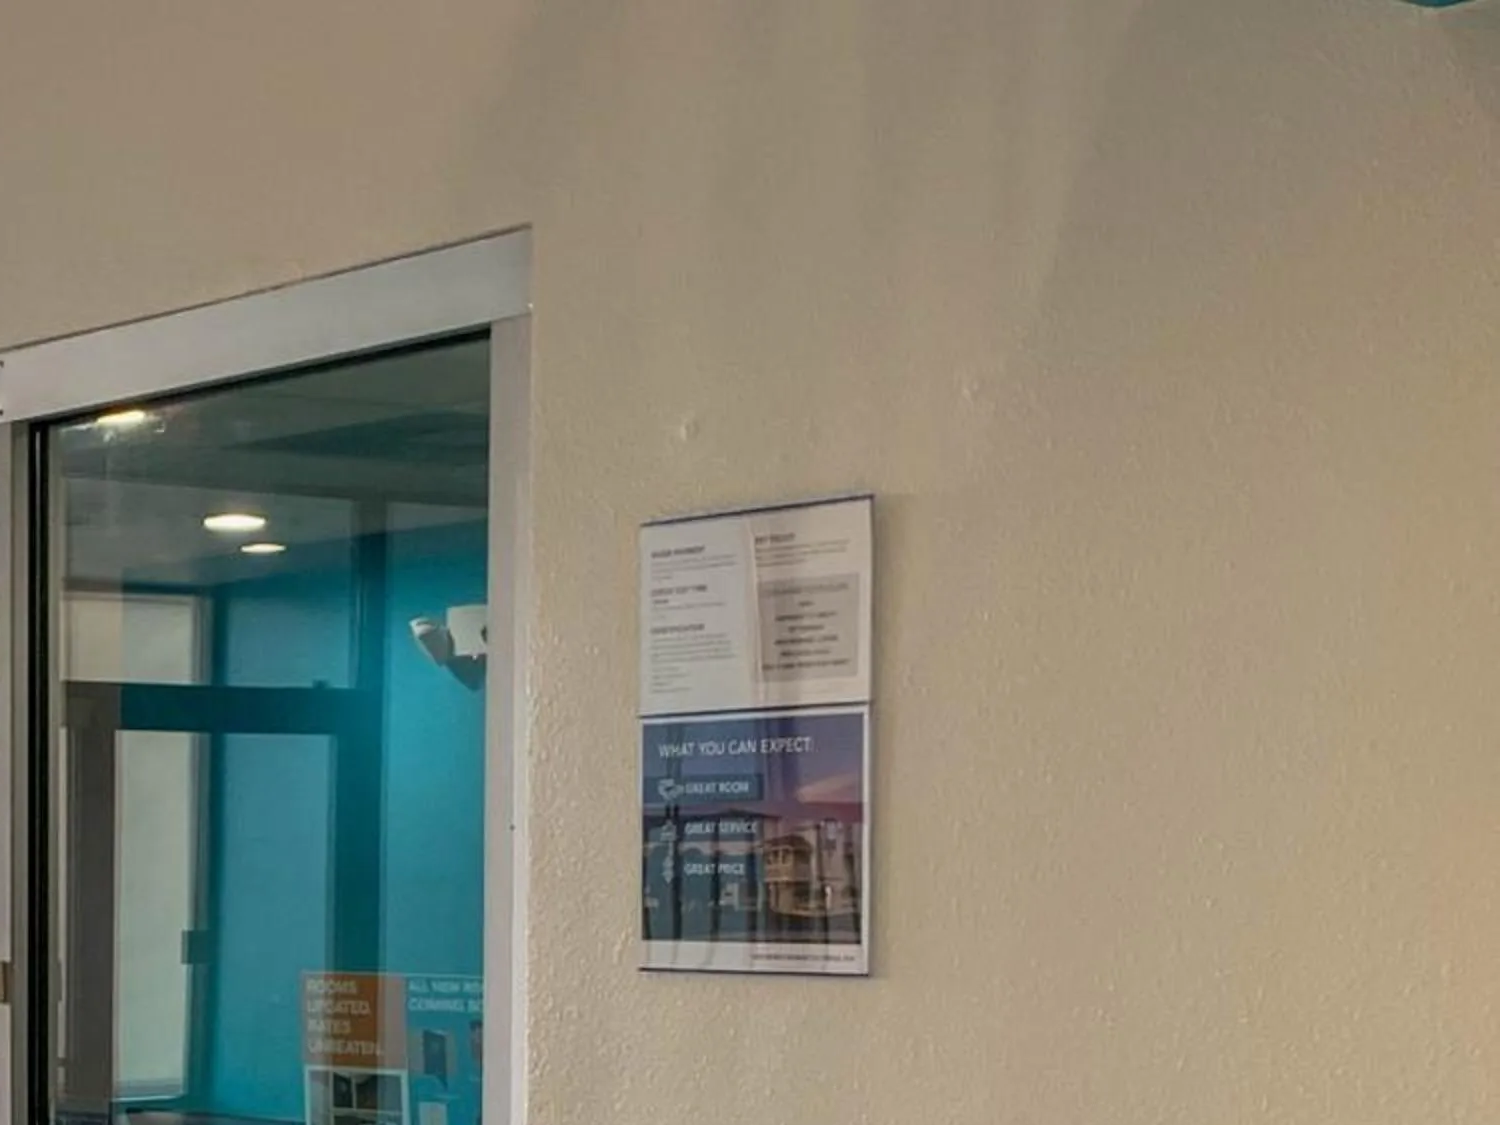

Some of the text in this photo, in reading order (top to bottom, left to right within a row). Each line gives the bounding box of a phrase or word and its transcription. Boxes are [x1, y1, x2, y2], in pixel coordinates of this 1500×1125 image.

[658, 742, 695, 757] WHAT
[700, 740, 725, 755] YOU
[728, 739, 756, 754] CAN
[684, 822, 715, 834] GREAT
